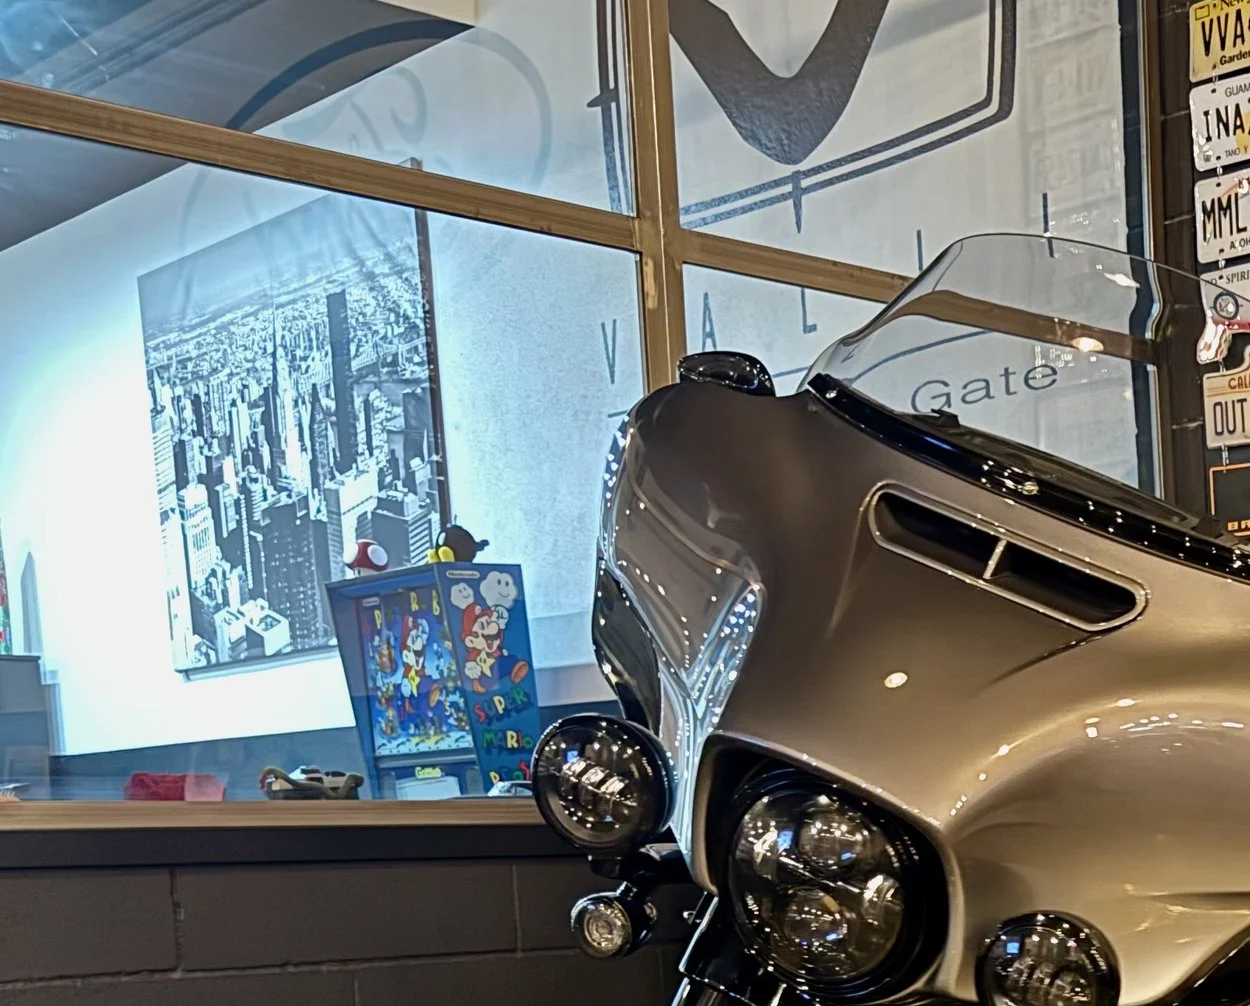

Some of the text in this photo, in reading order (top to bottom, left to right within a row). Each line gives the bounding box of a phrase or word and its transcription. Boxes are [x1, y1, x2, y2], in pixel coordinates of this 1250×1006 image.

[1201, 192, 1248, 243] MML
[910, 363, 1059, 414] Gate
[482, 729, 534, 751] MARIO
